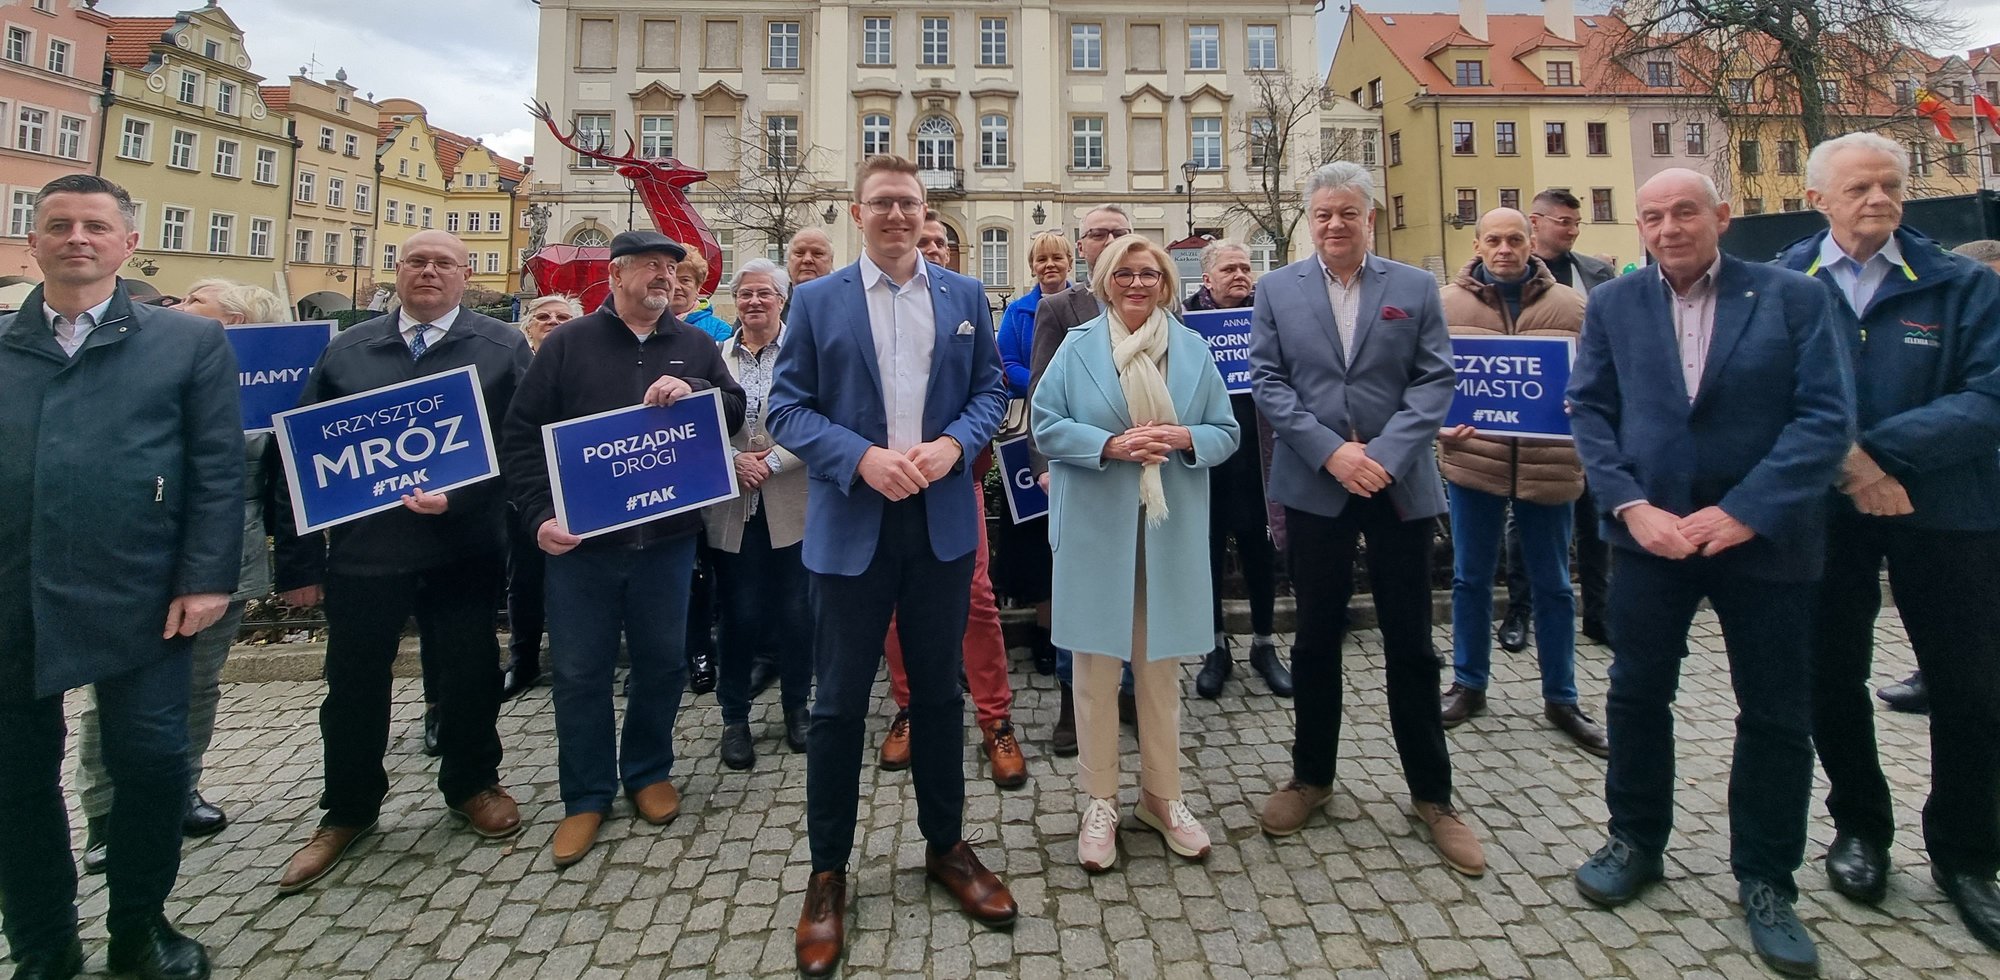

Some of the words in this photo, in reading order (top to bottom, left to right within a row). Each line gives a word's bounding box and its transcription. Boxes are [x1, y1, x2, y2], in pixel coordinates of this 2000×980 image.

[1223, 318, 1251, 327] ANNA
[1212, 348, 1250, 362] RTKI
[1452, 354, 1543, 375] CZYSTE
[1454, 378, 1543, 400] MIASTO
[322, 394, 445, 440] KRZYSZTOF
[1472, 409, 1520, 424] #TAK
[312, 415, 470, 489] MRÓZ
[583, 423, 697, 463] PORZĄDNE
[612, 448, 677, 478] DROGI
[372, 468, 430, 497] #TAK
[626, 486, 677, 511] #TAK
